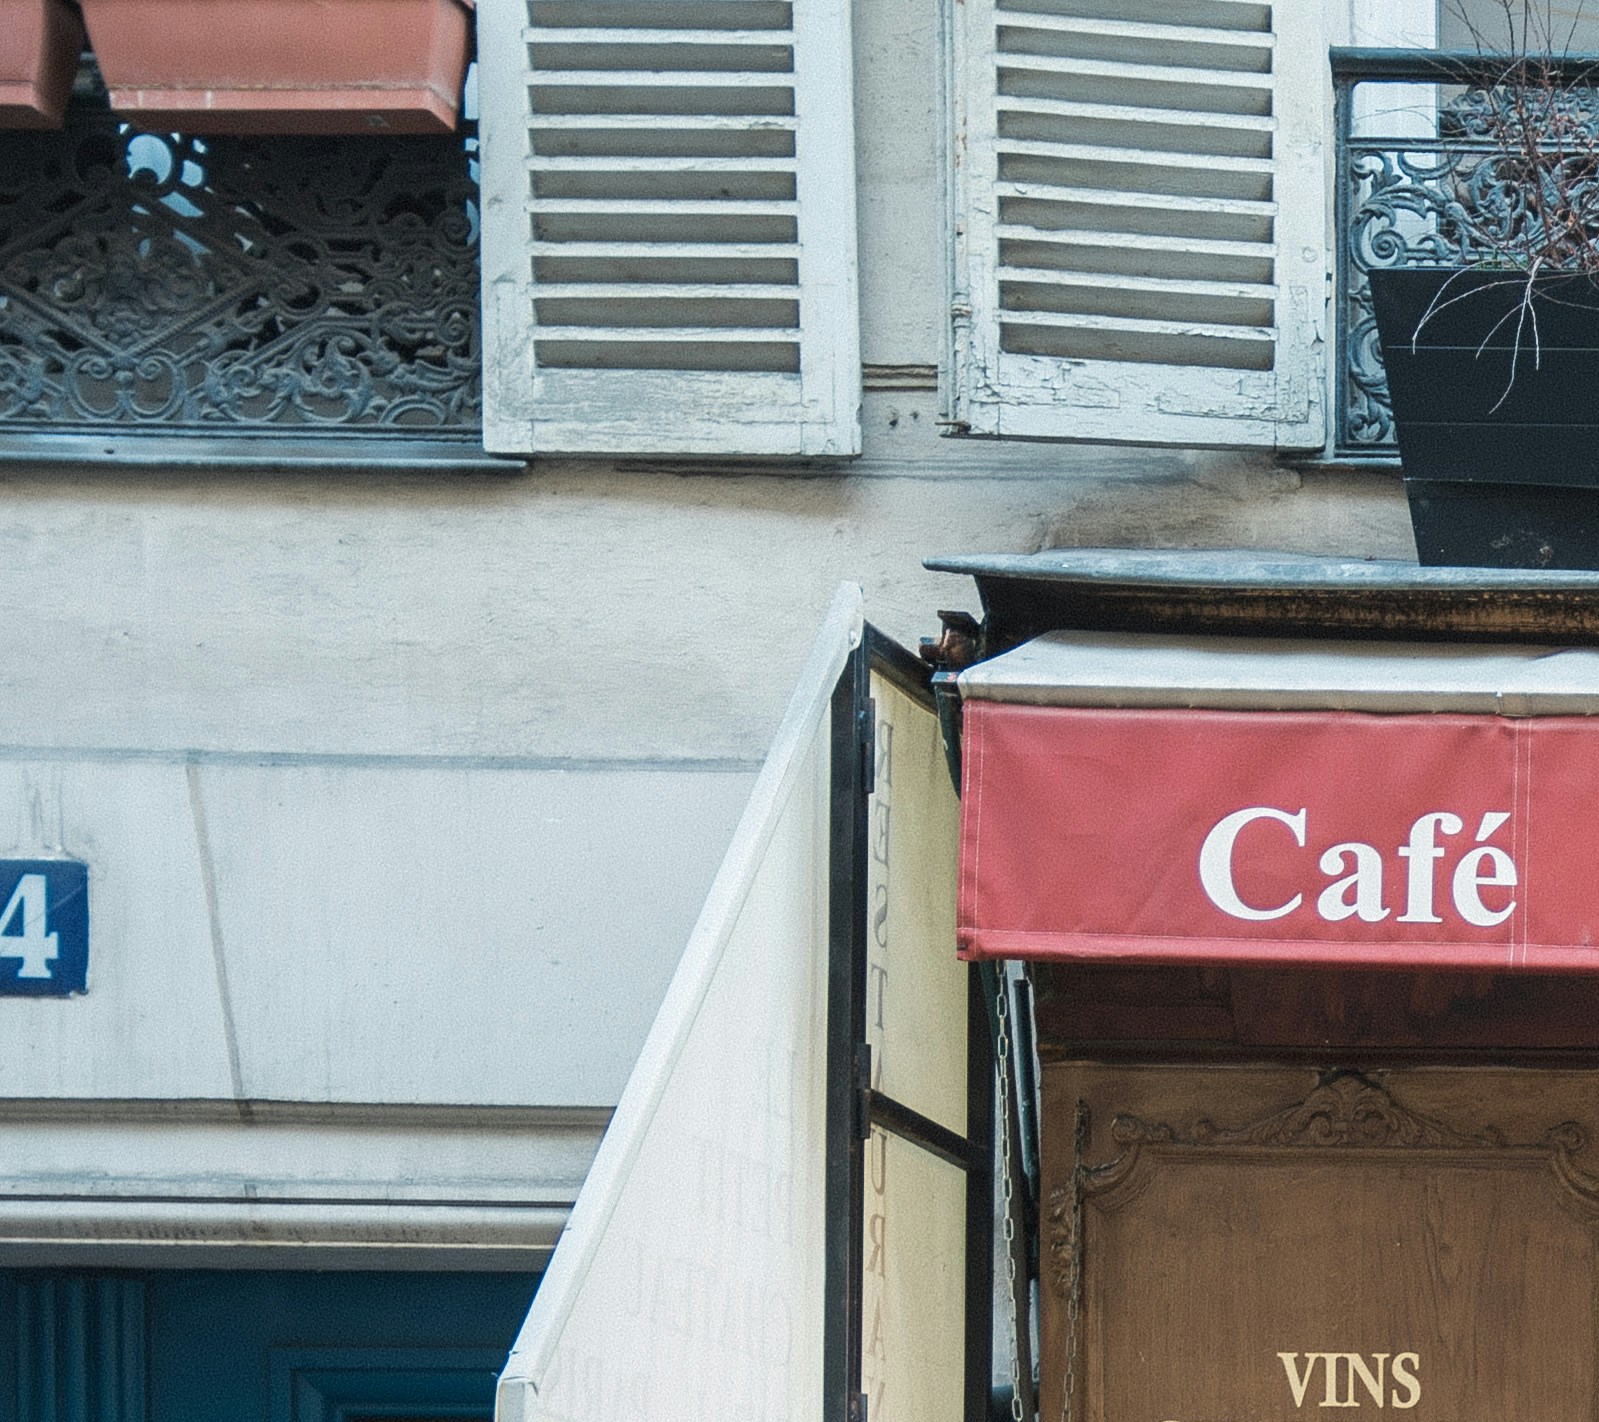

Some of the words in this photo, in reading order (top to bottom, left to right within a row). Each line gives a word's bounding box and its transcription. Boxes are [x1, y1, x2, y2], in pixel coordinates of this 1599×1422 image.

[1199, 808, 1517, 926] Café
[0, 874, 59, 979] 4
[1277, 1352, 1421, 1409] VINS
